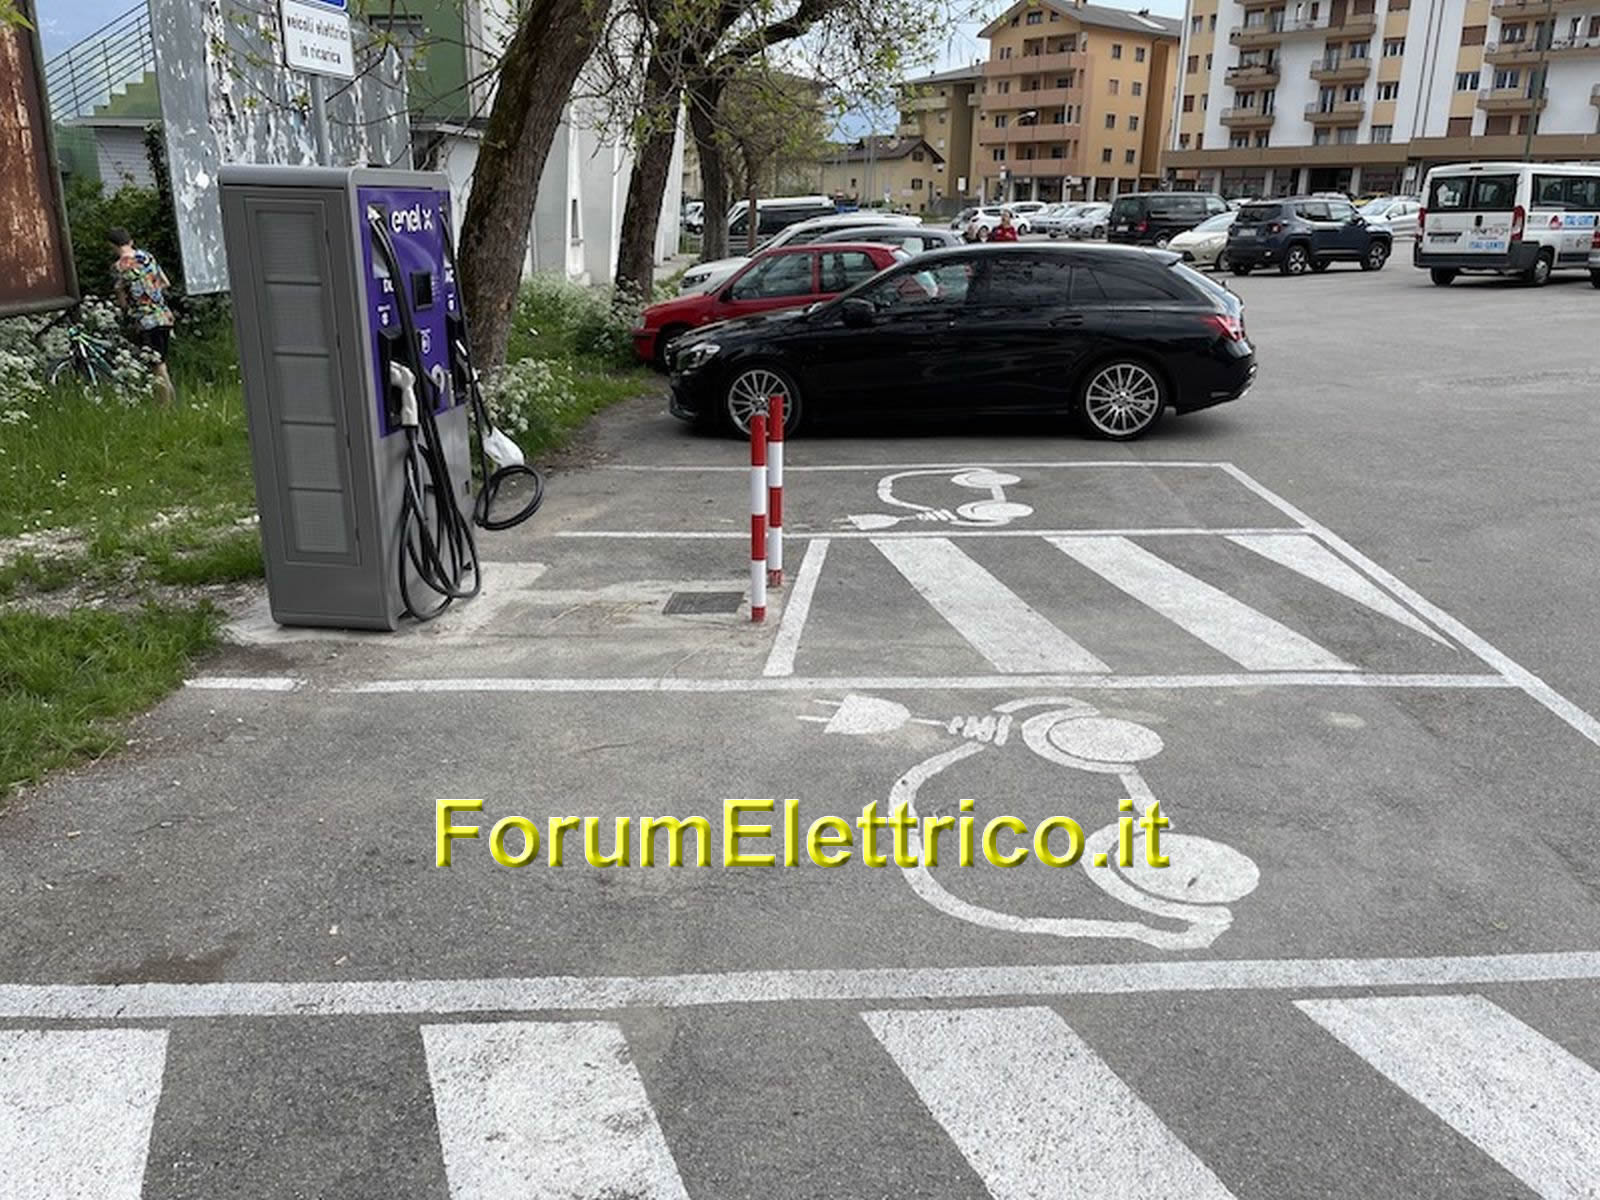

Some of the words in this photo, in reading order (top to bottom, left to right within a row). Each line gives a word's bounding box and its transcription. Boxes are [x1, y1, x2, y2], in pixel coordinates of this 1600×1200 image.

[287, 13, 314, 33] veicoli
[299, 39, 309, 58] in
[310, 42, 342, 65] ricarica
[391, 203, 422, 233] enel
